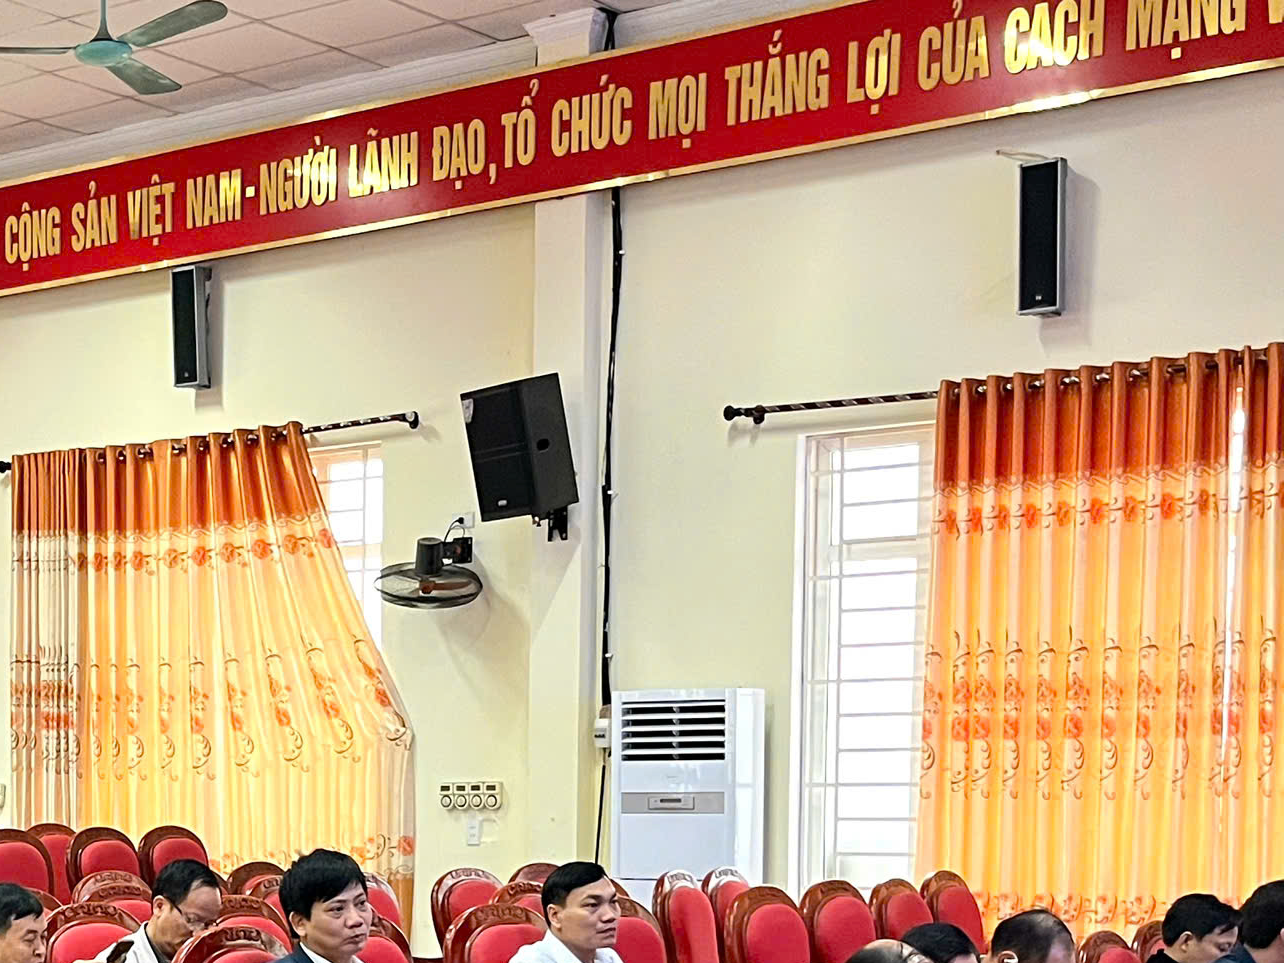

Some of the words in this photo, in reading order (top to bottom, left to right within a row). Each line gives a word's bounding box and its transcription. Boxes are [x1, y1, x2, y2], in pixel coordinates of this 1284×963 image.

[5, 201, 62, 272] CỘNG
[71, 180, 117, 253] SẢN
[127, 173, 176, 246] VIỆT
[348, 127, 419, 198] LÃNH
[551, 74, 633, 157] CHỨC
[648, 72, 707, 149] MỌI
[724, 29, 830, 126] THẮNG
[847, 28, 902, 115] LỢI
[917, 0, 990, 91] CỦA
